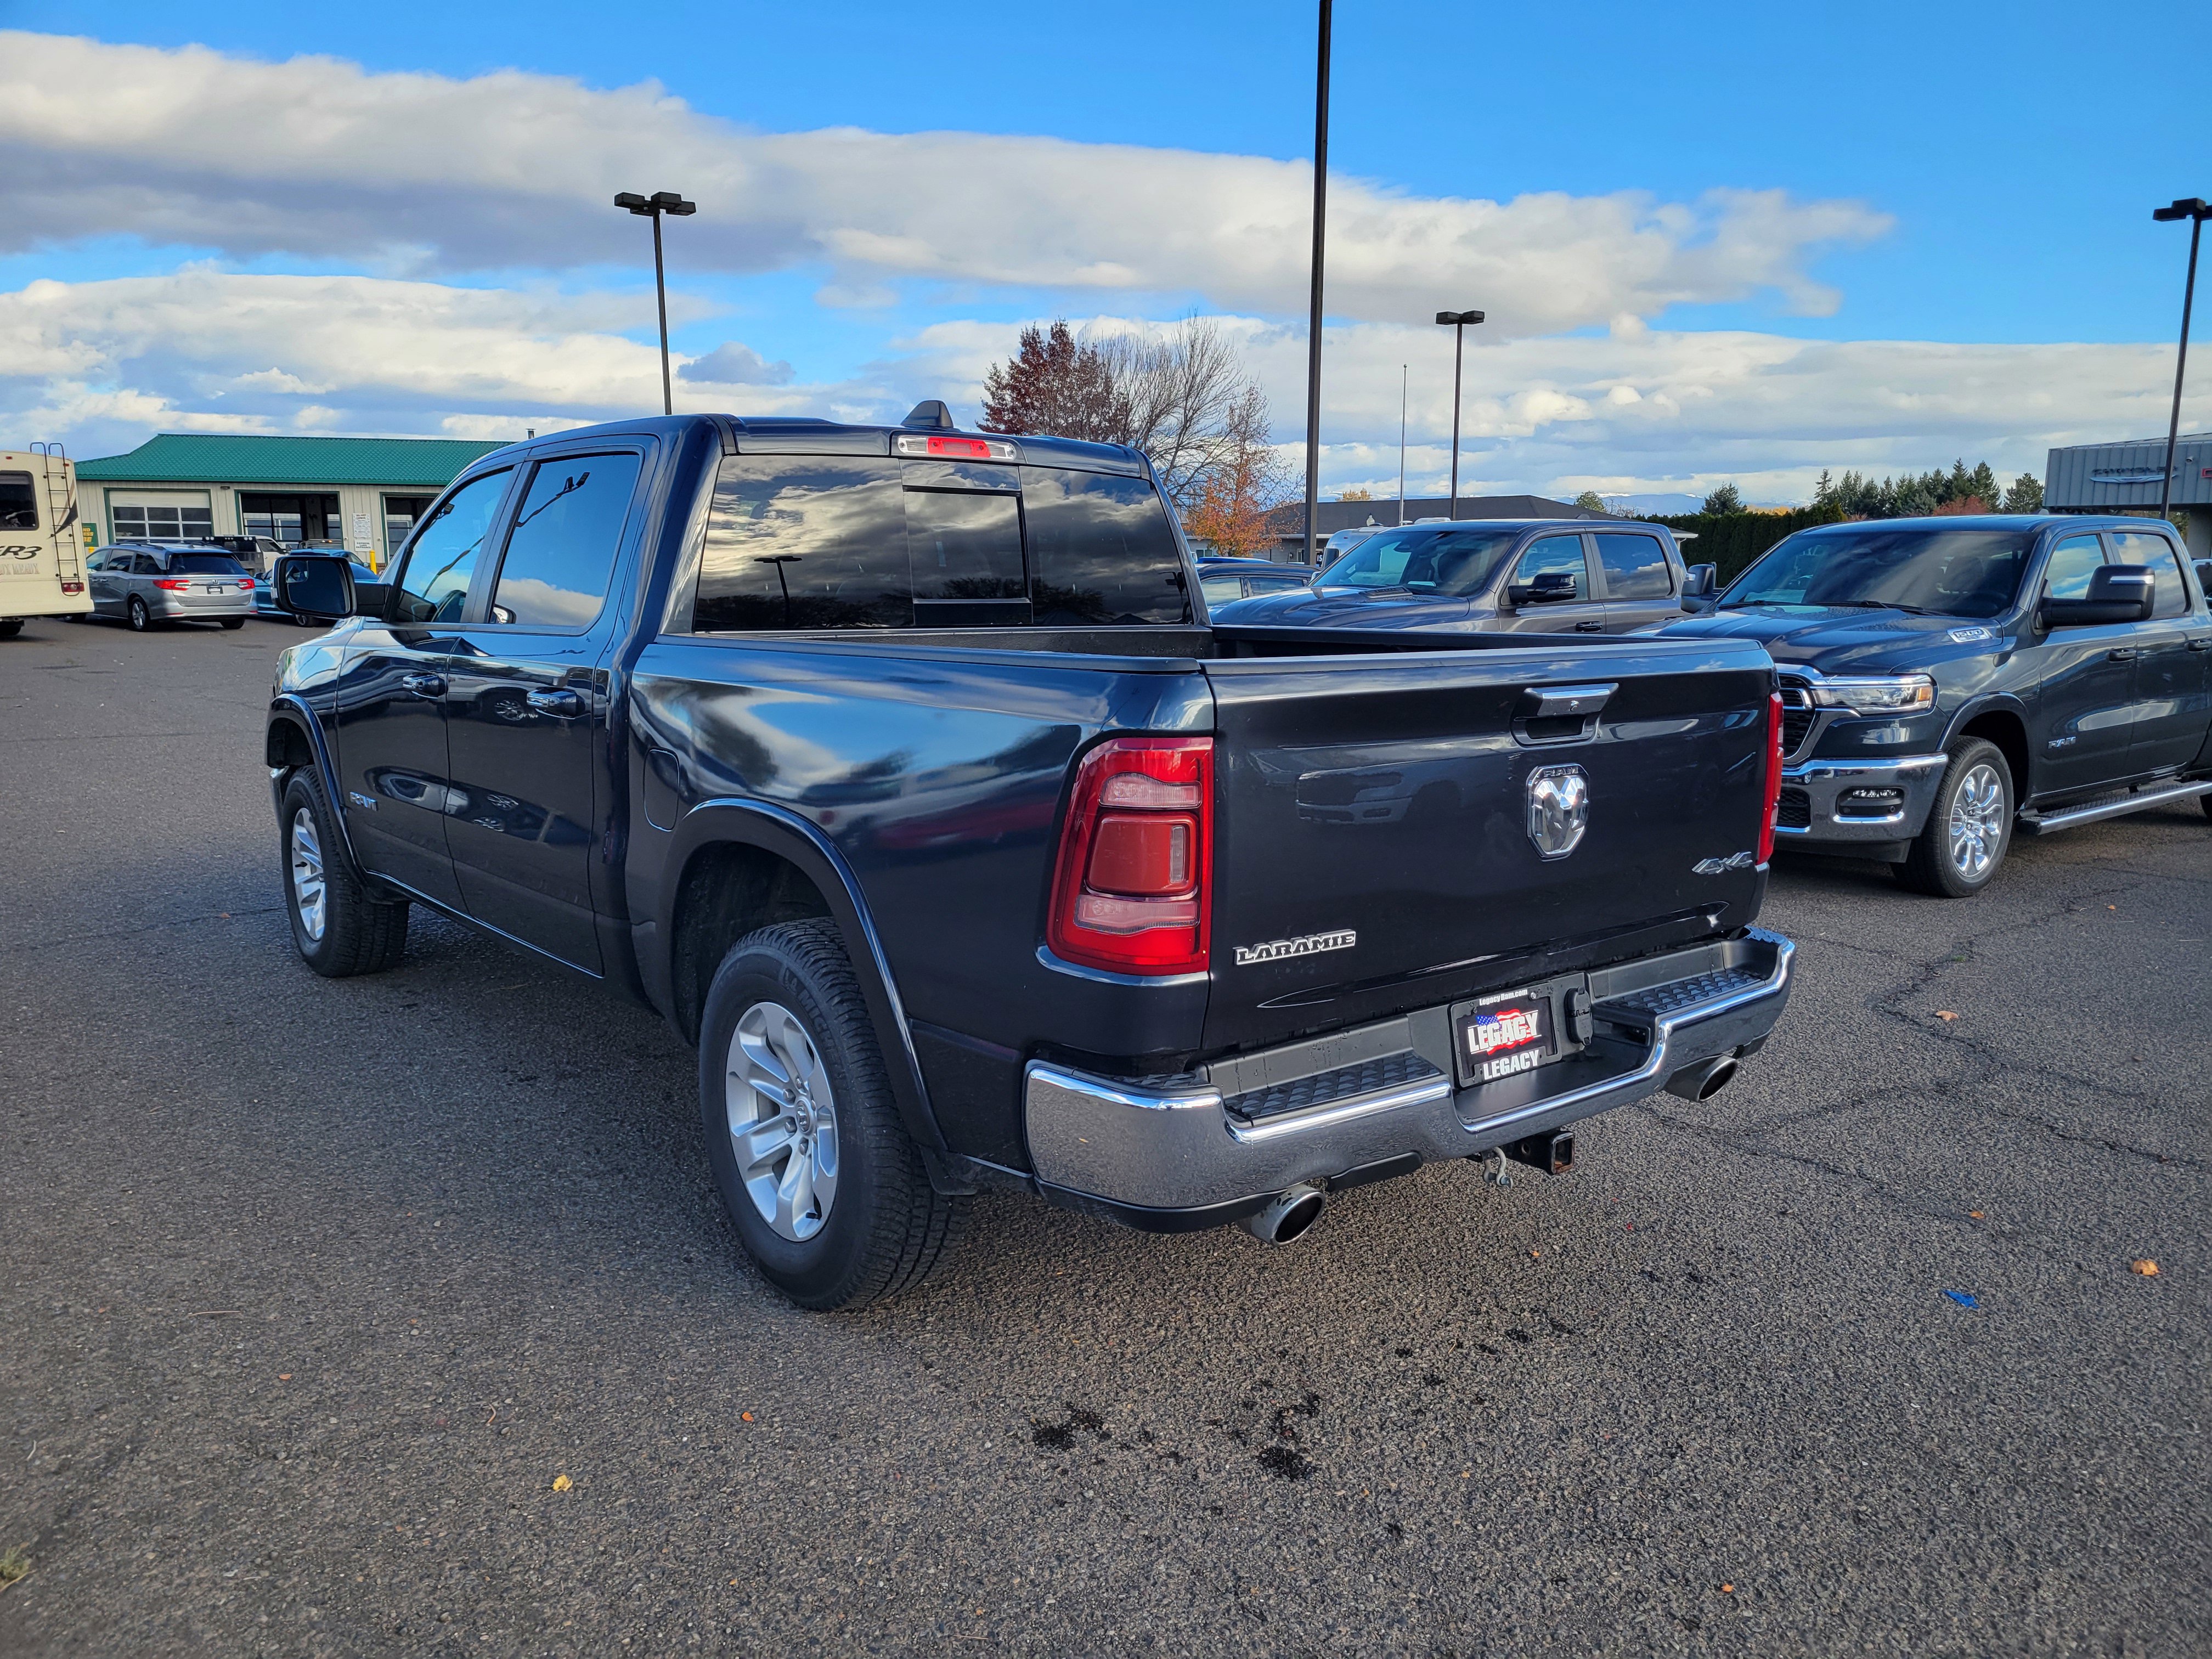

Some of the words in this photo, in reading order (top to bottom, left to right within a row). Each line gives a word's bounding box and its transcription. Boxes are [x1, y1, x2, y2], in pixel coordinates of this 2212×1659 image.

[0, 545, 42, 560] R3
[2048, 737, 2076, 749] RAM
[1543, 766, 1579, 777] RAM
[350, 792, 377, 812] RAM
[1234, 929, 1356, 965] LARAMIE
[1468, 1012, 1538, 1052] LEGACY
[1483, 1049, 1539, 1080] LEGACY
